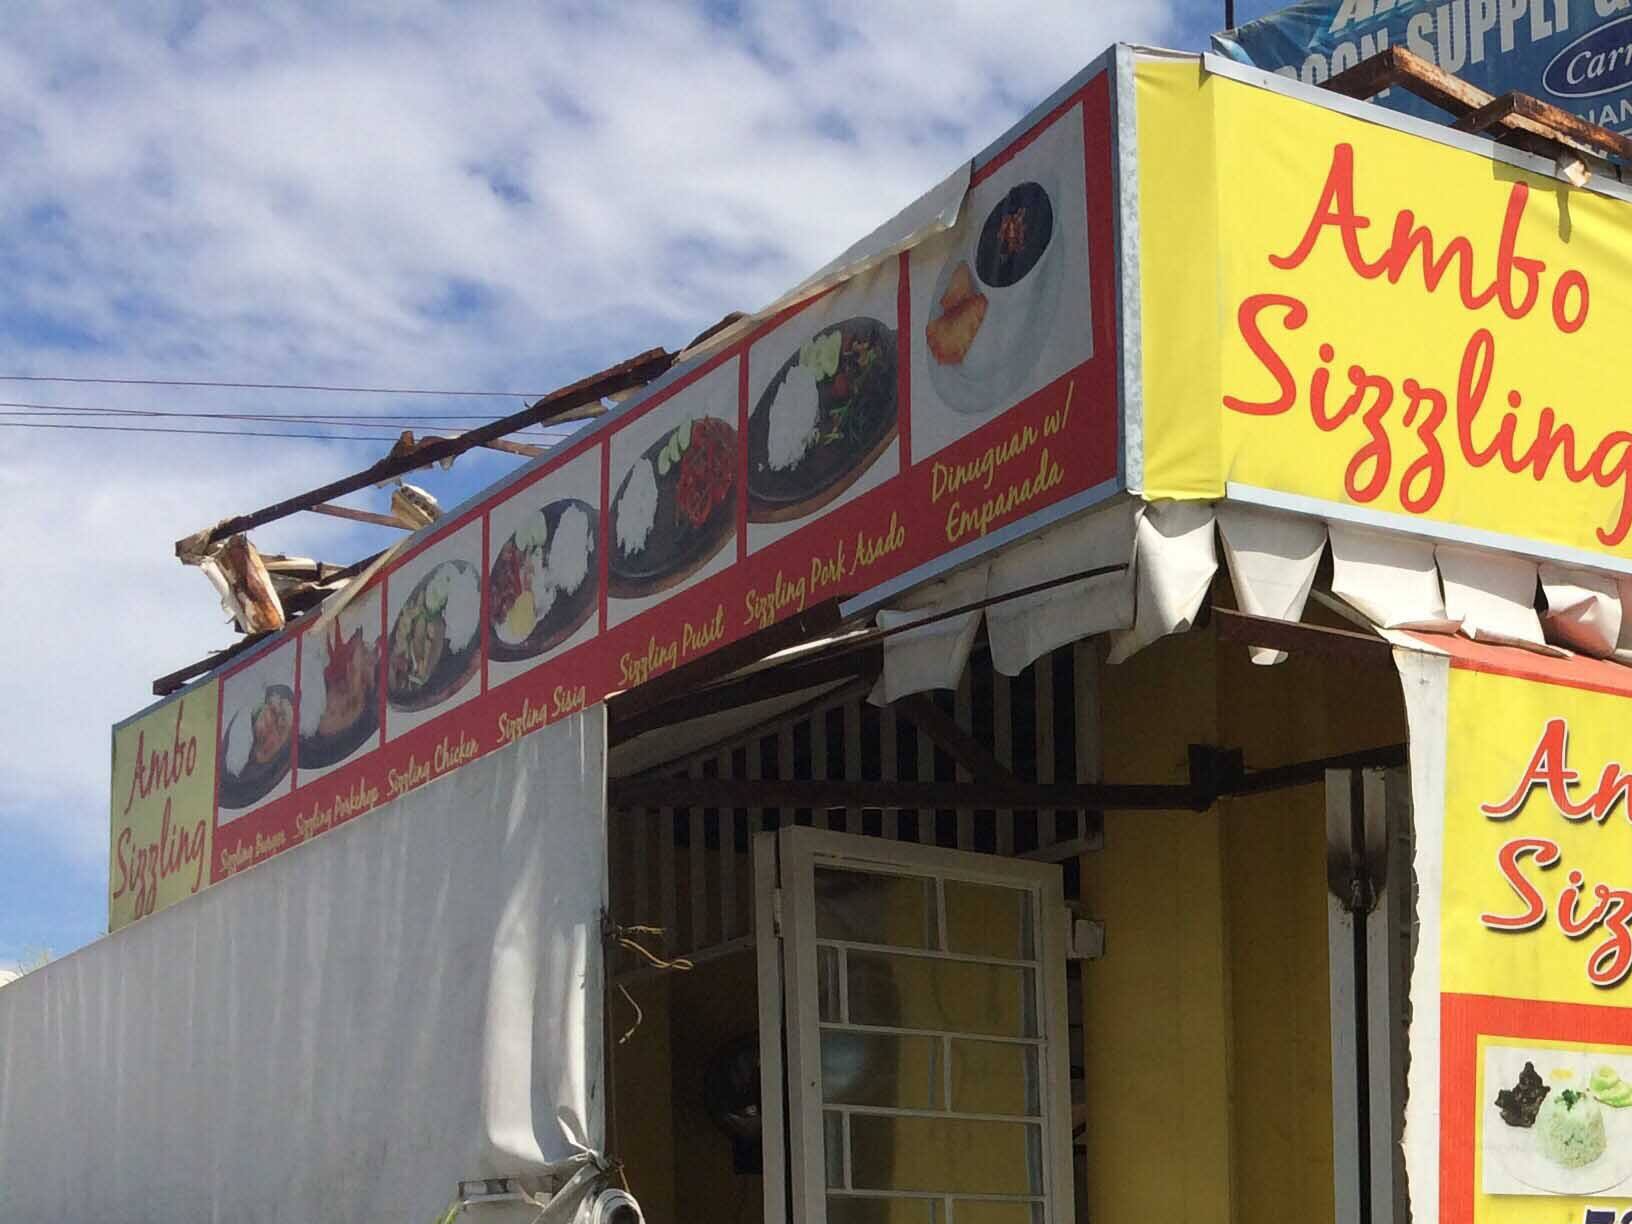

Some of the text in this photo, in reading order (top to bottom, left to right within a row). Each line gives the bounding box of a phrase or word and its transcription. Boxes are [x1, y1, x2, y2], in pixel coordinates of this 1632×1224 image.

[1268, 142, 1590, 333] Ambo
[931, 379, 1074, 503] Dinuguan w/
[945, 448, 1065, 542] Empanada
[743, 511, 905, 628] Sizzling Pork Asado
[617, 604, 725, 687] Sizzling Pusit
[123, 699, 198, 816] Ambo
[497, 686, 587, 743] Sizzling Sisig
[112, 796, 207, 920] Sizzling
